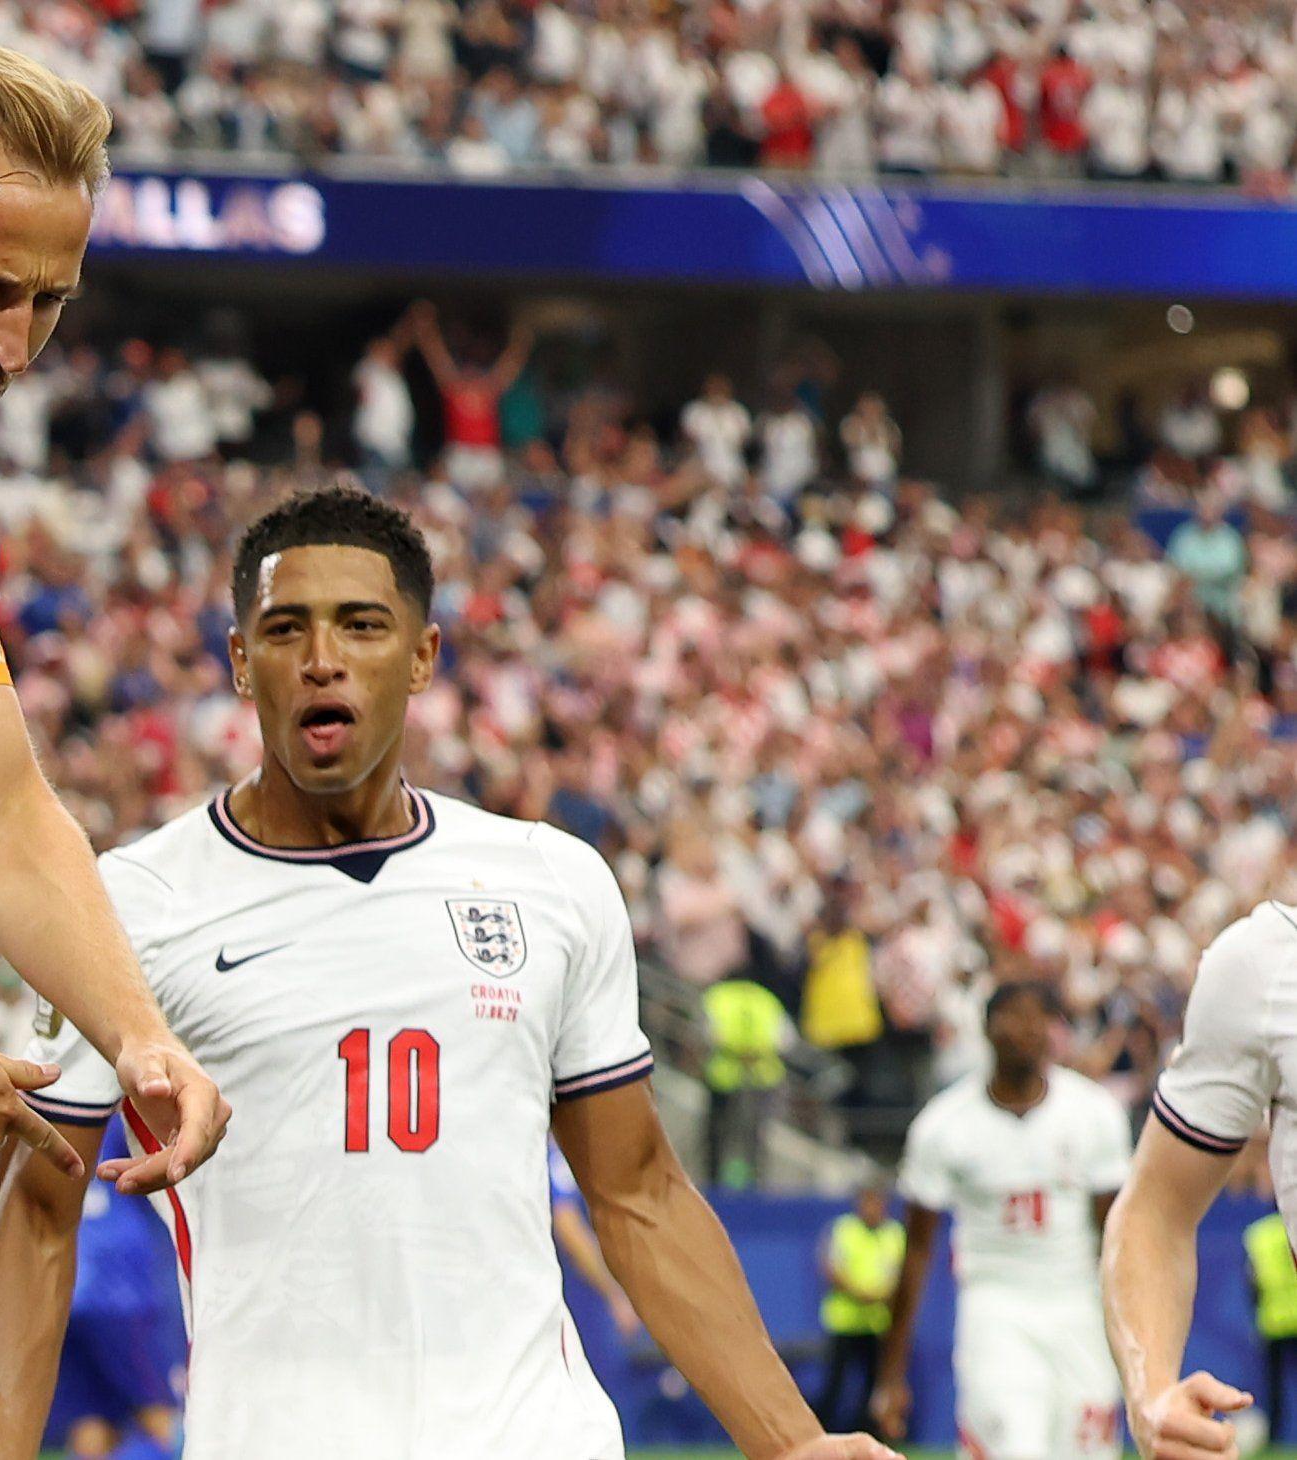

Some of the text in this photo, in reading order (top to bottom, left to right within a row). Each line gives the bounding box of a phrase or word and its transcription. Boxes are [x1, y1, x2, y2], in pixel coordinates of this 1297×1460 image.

[91, 177, 327, 254] ALLAS
[470, 984, 523, 1005] CROATIA
[337, 1028, 440, 1153] 10
